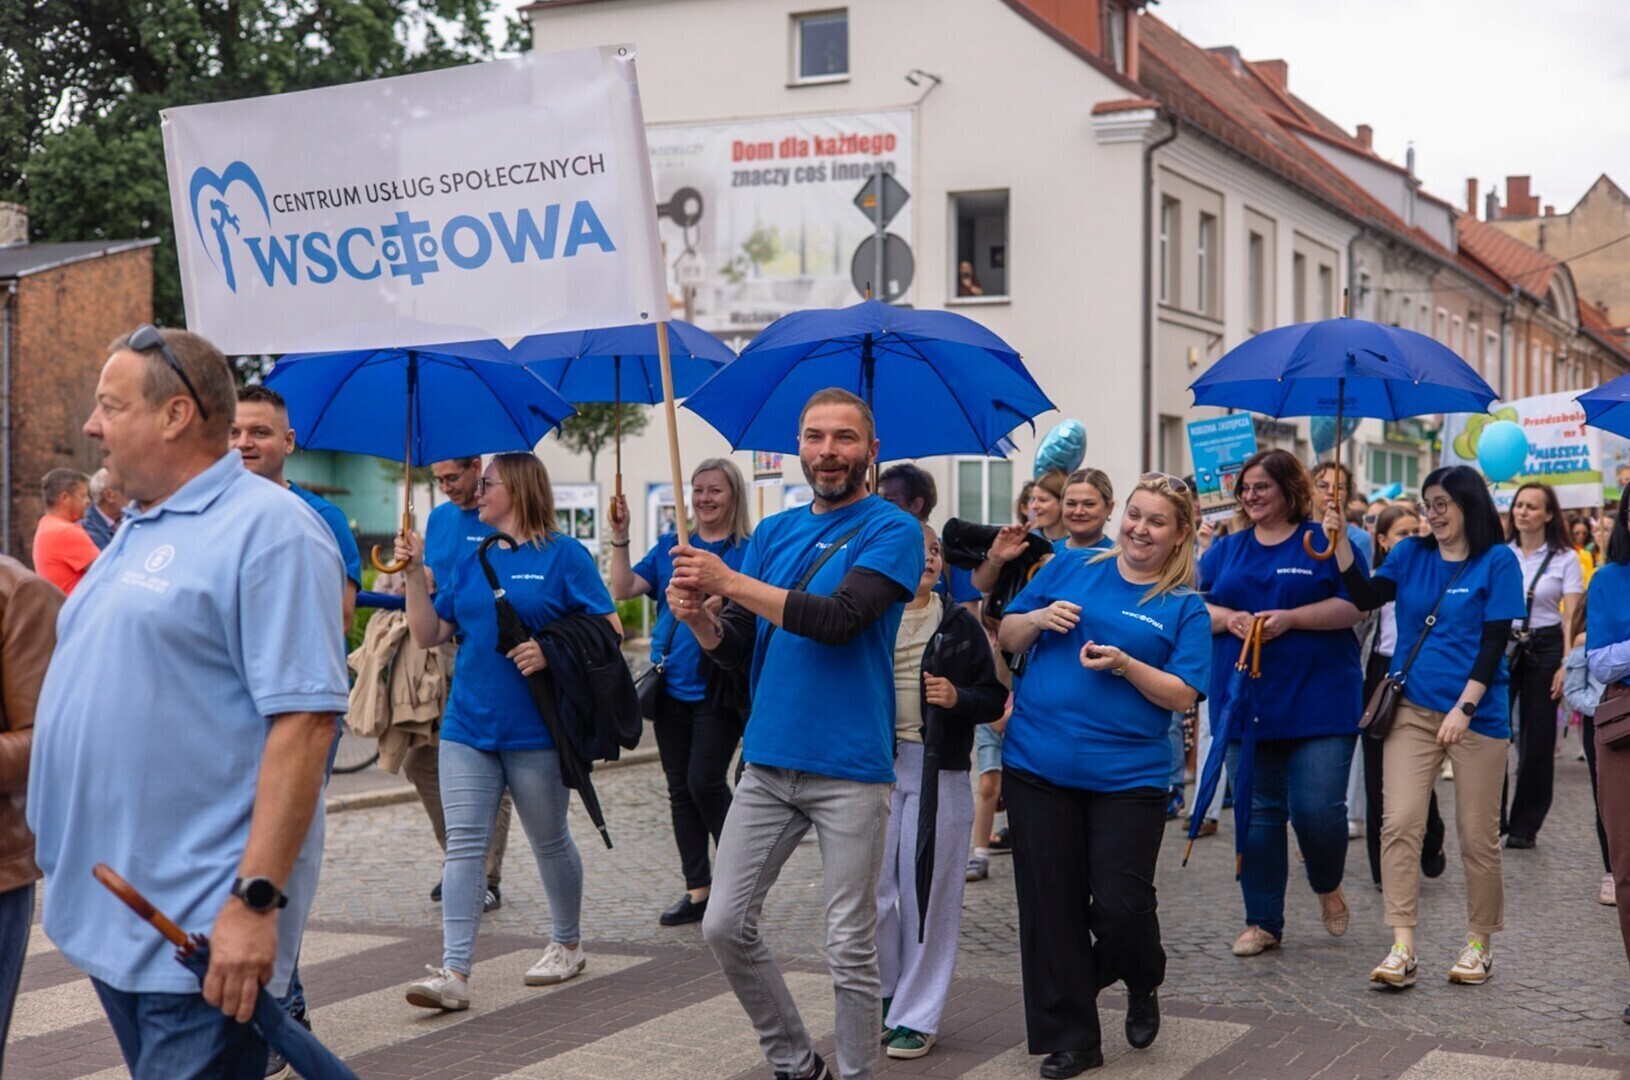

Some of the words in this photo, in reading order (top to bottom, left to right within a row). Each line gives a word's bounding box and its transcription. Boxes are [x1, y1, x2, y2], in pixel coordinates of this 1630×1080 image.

[732, 139, 774, 162] Dom
[779, 135, 809, 158] dla
[814, 132, 896, 156] każdego
[273, 185, 362, 213] CENTRUM
[364, 176, 435, 205] USŁUG
[439, 152, 606, 194] SPOŁECZNYCH
[731, 167, 791, 188] znaczy
[794, 161, 827, 183] coś
